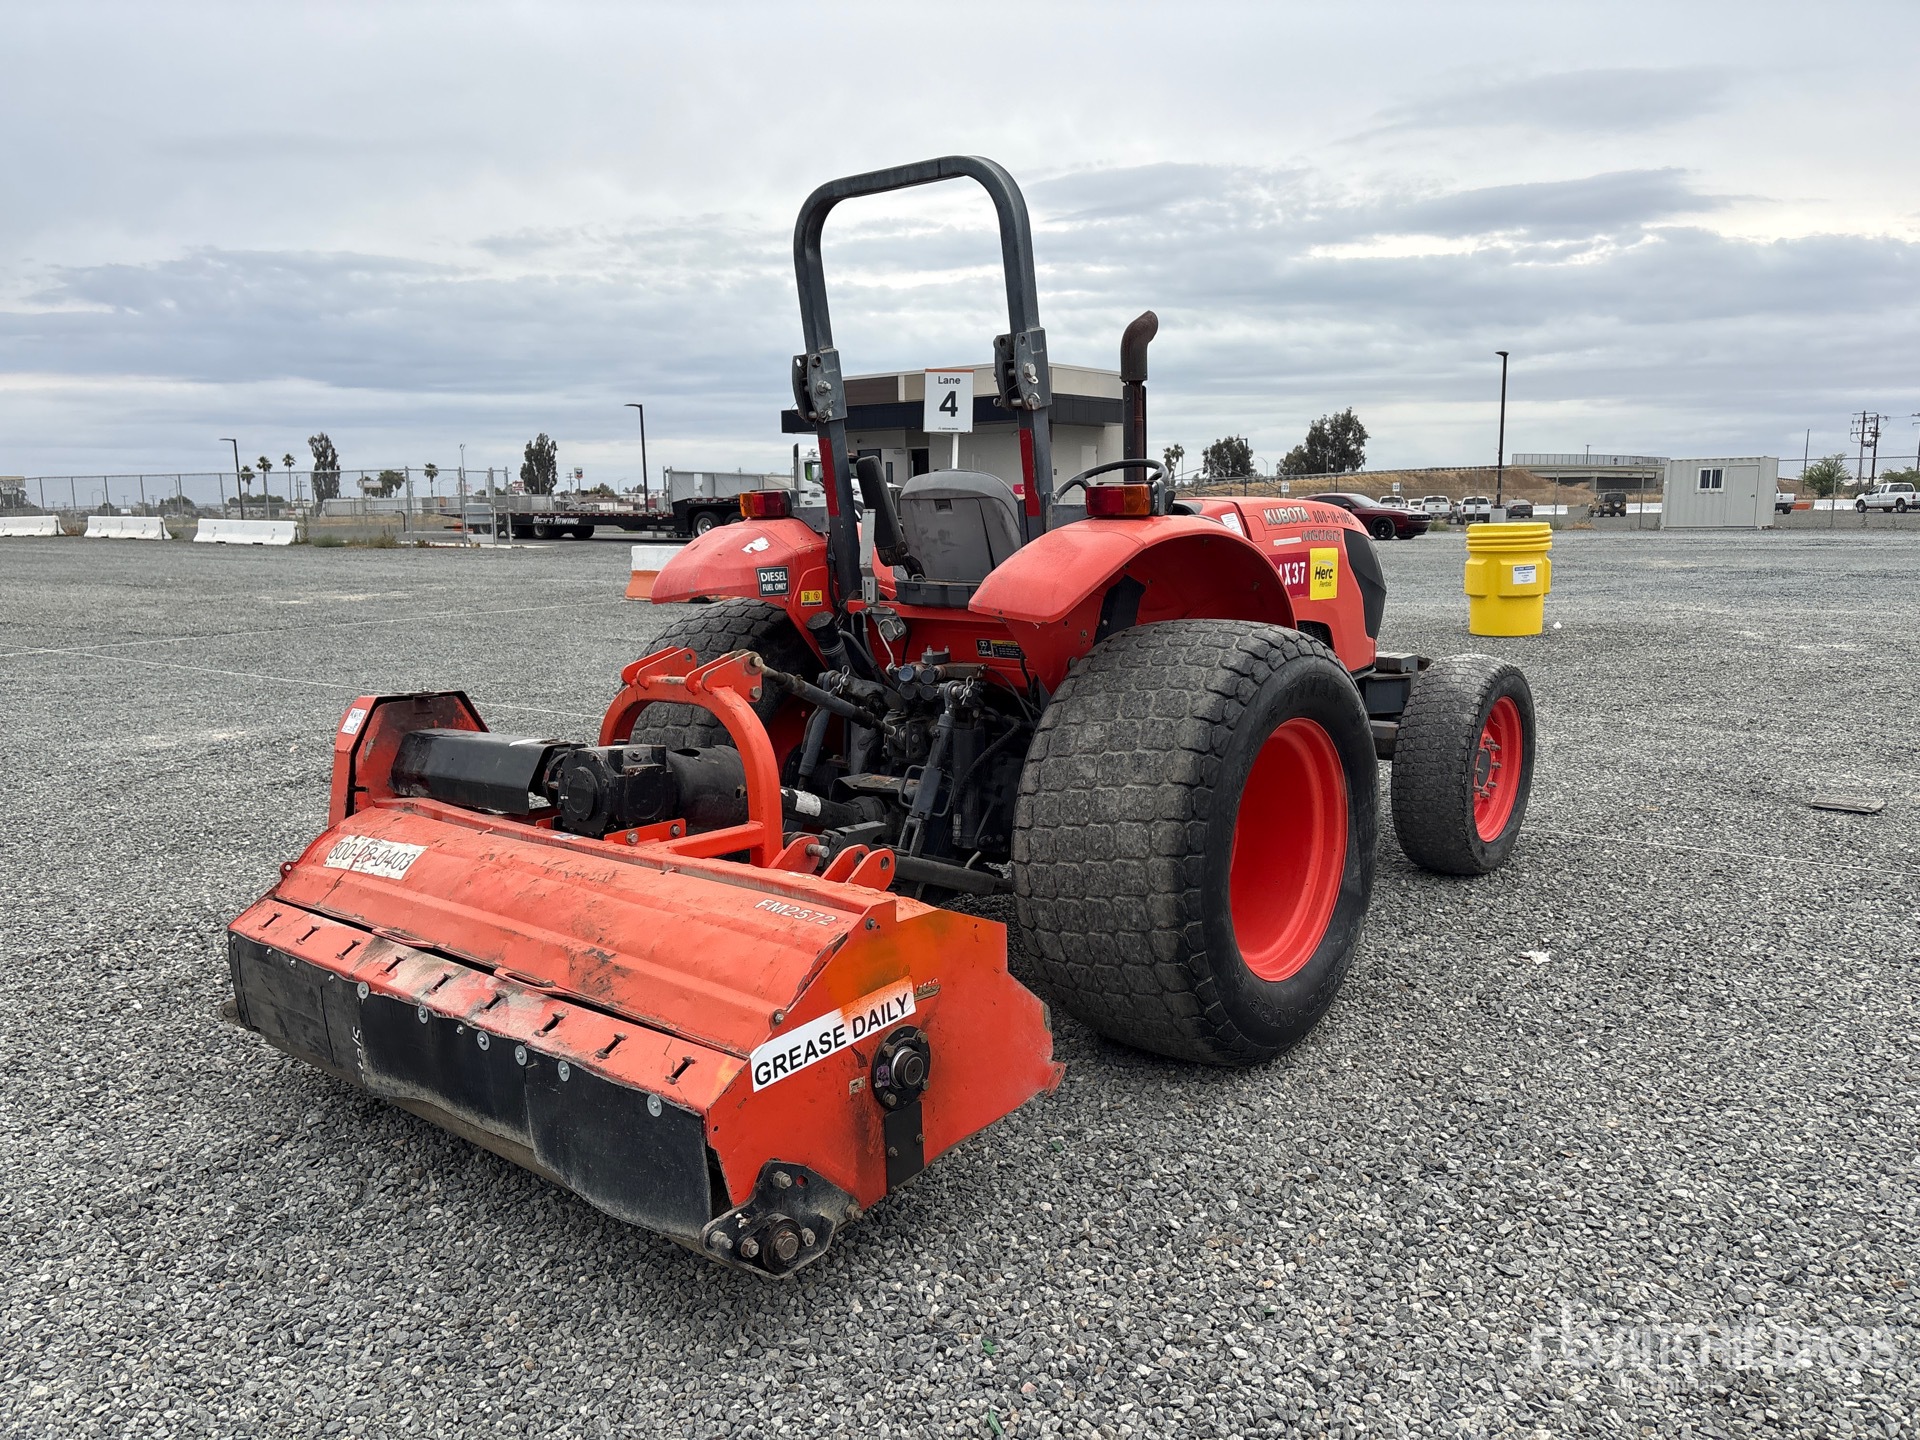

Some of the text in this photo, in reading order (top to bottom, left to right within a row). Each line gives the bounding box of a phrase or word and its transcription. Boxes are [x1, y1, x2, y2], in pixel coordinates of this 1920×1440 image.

[938, 375, 961, 385] Lane
[939, 390, 959, 418] 4
[1263, 506, 1311, 526] KUBOTA
[760, 571, 787, 582] DIESEL
[1314, 566, 1334, 580] Herc
[762, 583, 787, 592] FUEL ONLY
[754, 899, 838, 926] FM2572
[754, 992, 909, 1086] GREASE DAILY
